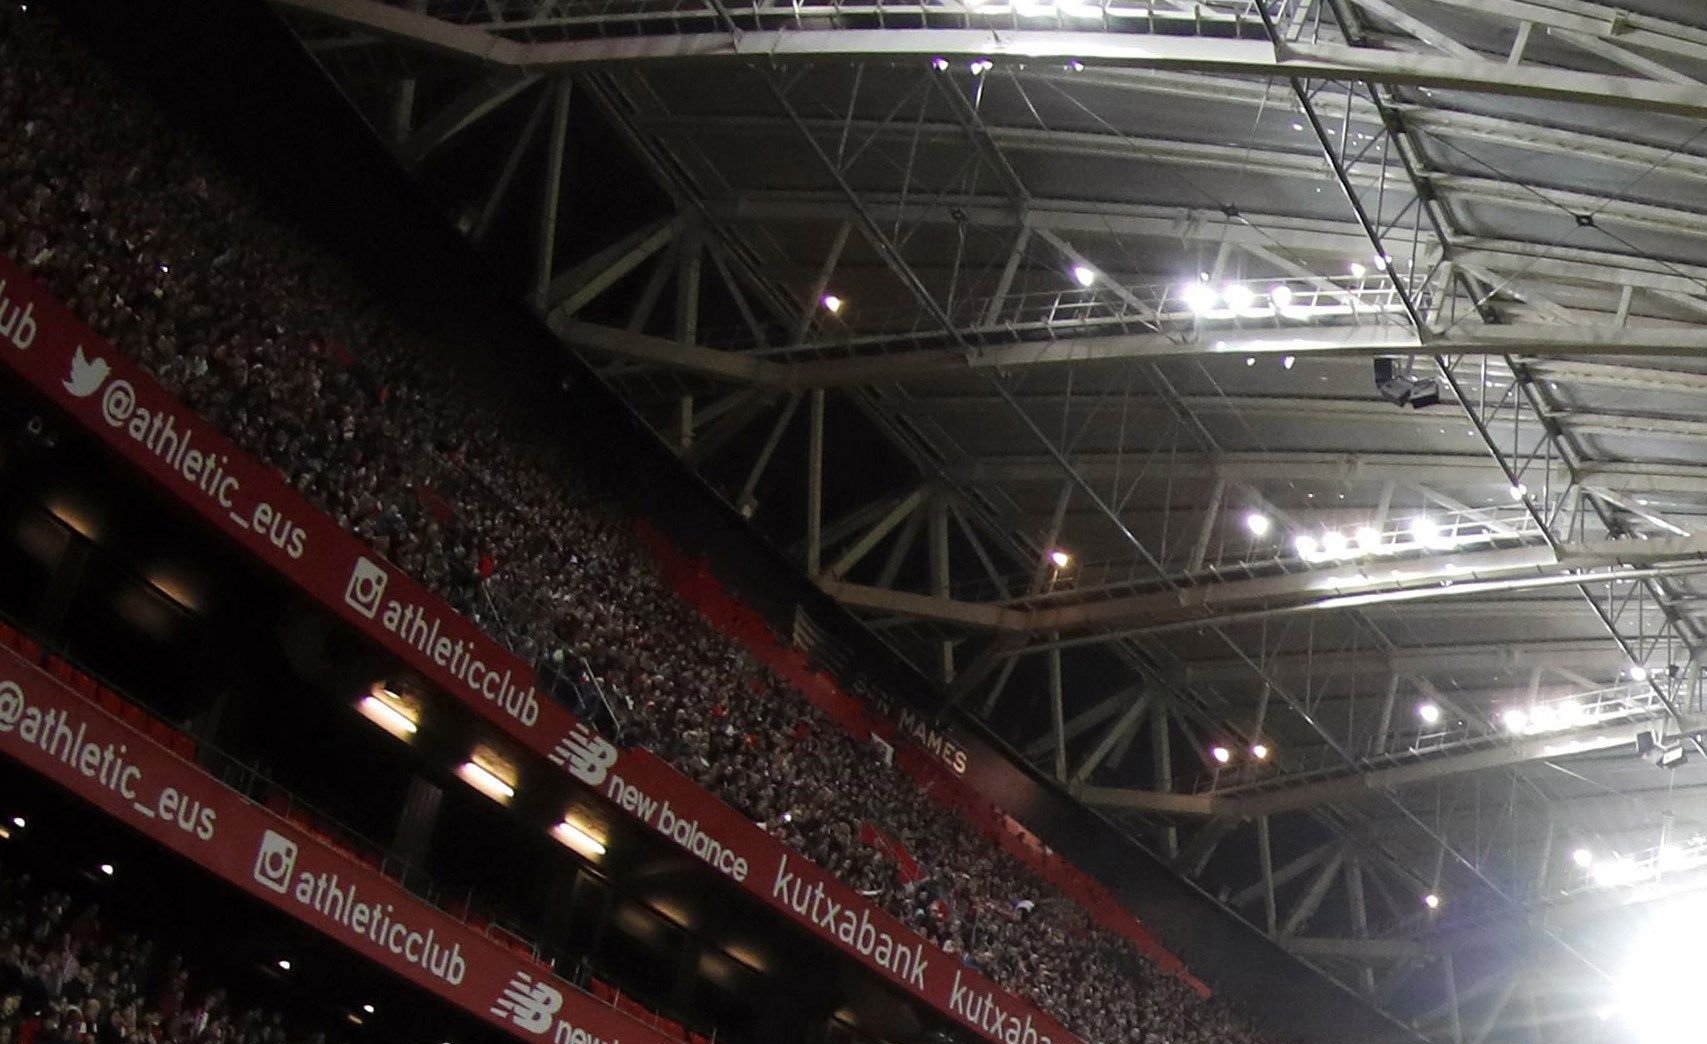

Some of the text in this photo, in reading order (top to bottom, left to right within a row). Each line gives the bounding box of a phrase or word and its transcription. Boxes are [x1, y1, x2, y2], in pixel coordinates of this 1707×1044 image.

[102, 380, 307, 559] @athletic_eus
[382, 600, 540, 727] athleticclub
[0, 680, 216, 841] @athletic_eus
[608, 774, 748, 882] new balance
[296, 872, 466, 985] athleticclub
[773, 854, 928, 990] kutxabank
